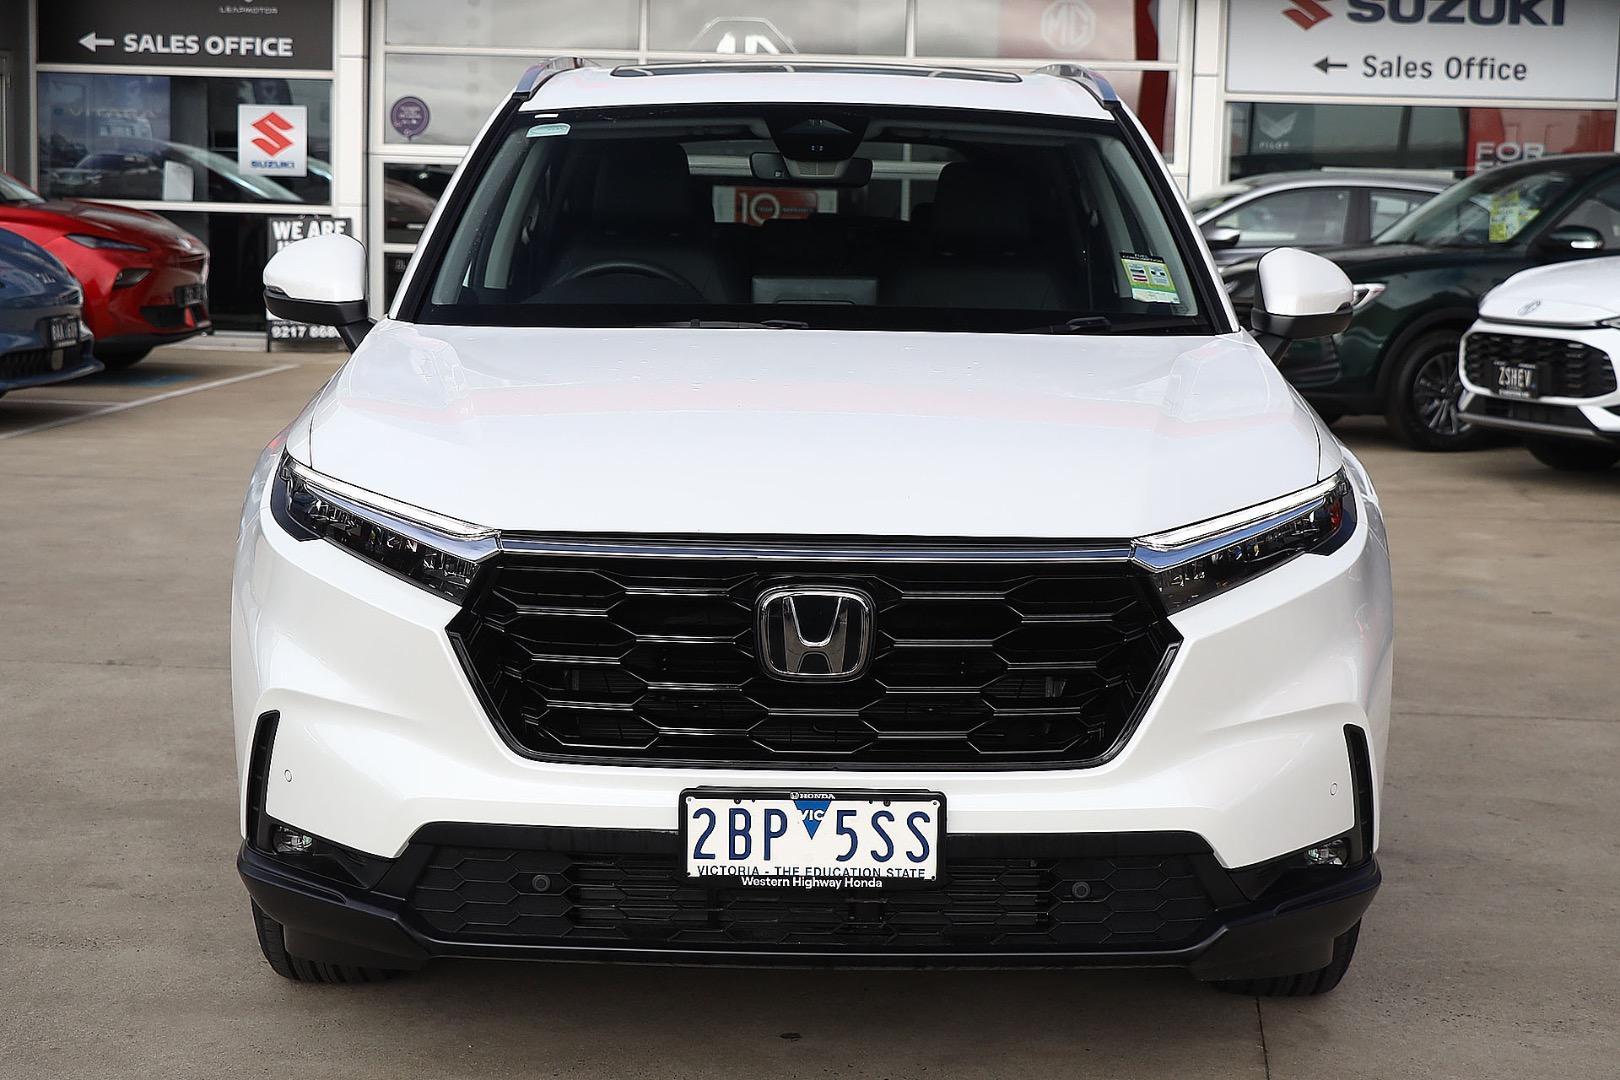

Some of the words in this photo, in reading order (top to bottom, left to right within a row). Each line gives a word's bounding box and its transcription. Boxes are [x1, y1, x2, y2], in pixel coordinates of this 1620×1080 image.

[1347, 0, 1565, 26] SUZUKI
[123, 34, 200, 55] SALES
[204, 36, 294, 57] OFFICE
[1362, 54, 1433, 80] Sales
[1445, 56, 1528, 82] Office
[1476, 142, 1544, 161] FOR
[272, 220, 304, 240] WE
[799, 810, 825, 821] VIC
[692, 807, 788, 861] 2BP
[835, 809, 931, 863] 5SS
[697, 865, 760, 876] VICTORIA
[774, 866, 800, 876] THE
[805, 867, 881, 877] EDUCATION
[886, 868, 926, 878] STATE
[741, 876, 790, 887] Western
[793, 876, 842, 890] Highway
[844, 877, 883, 888] Honda
